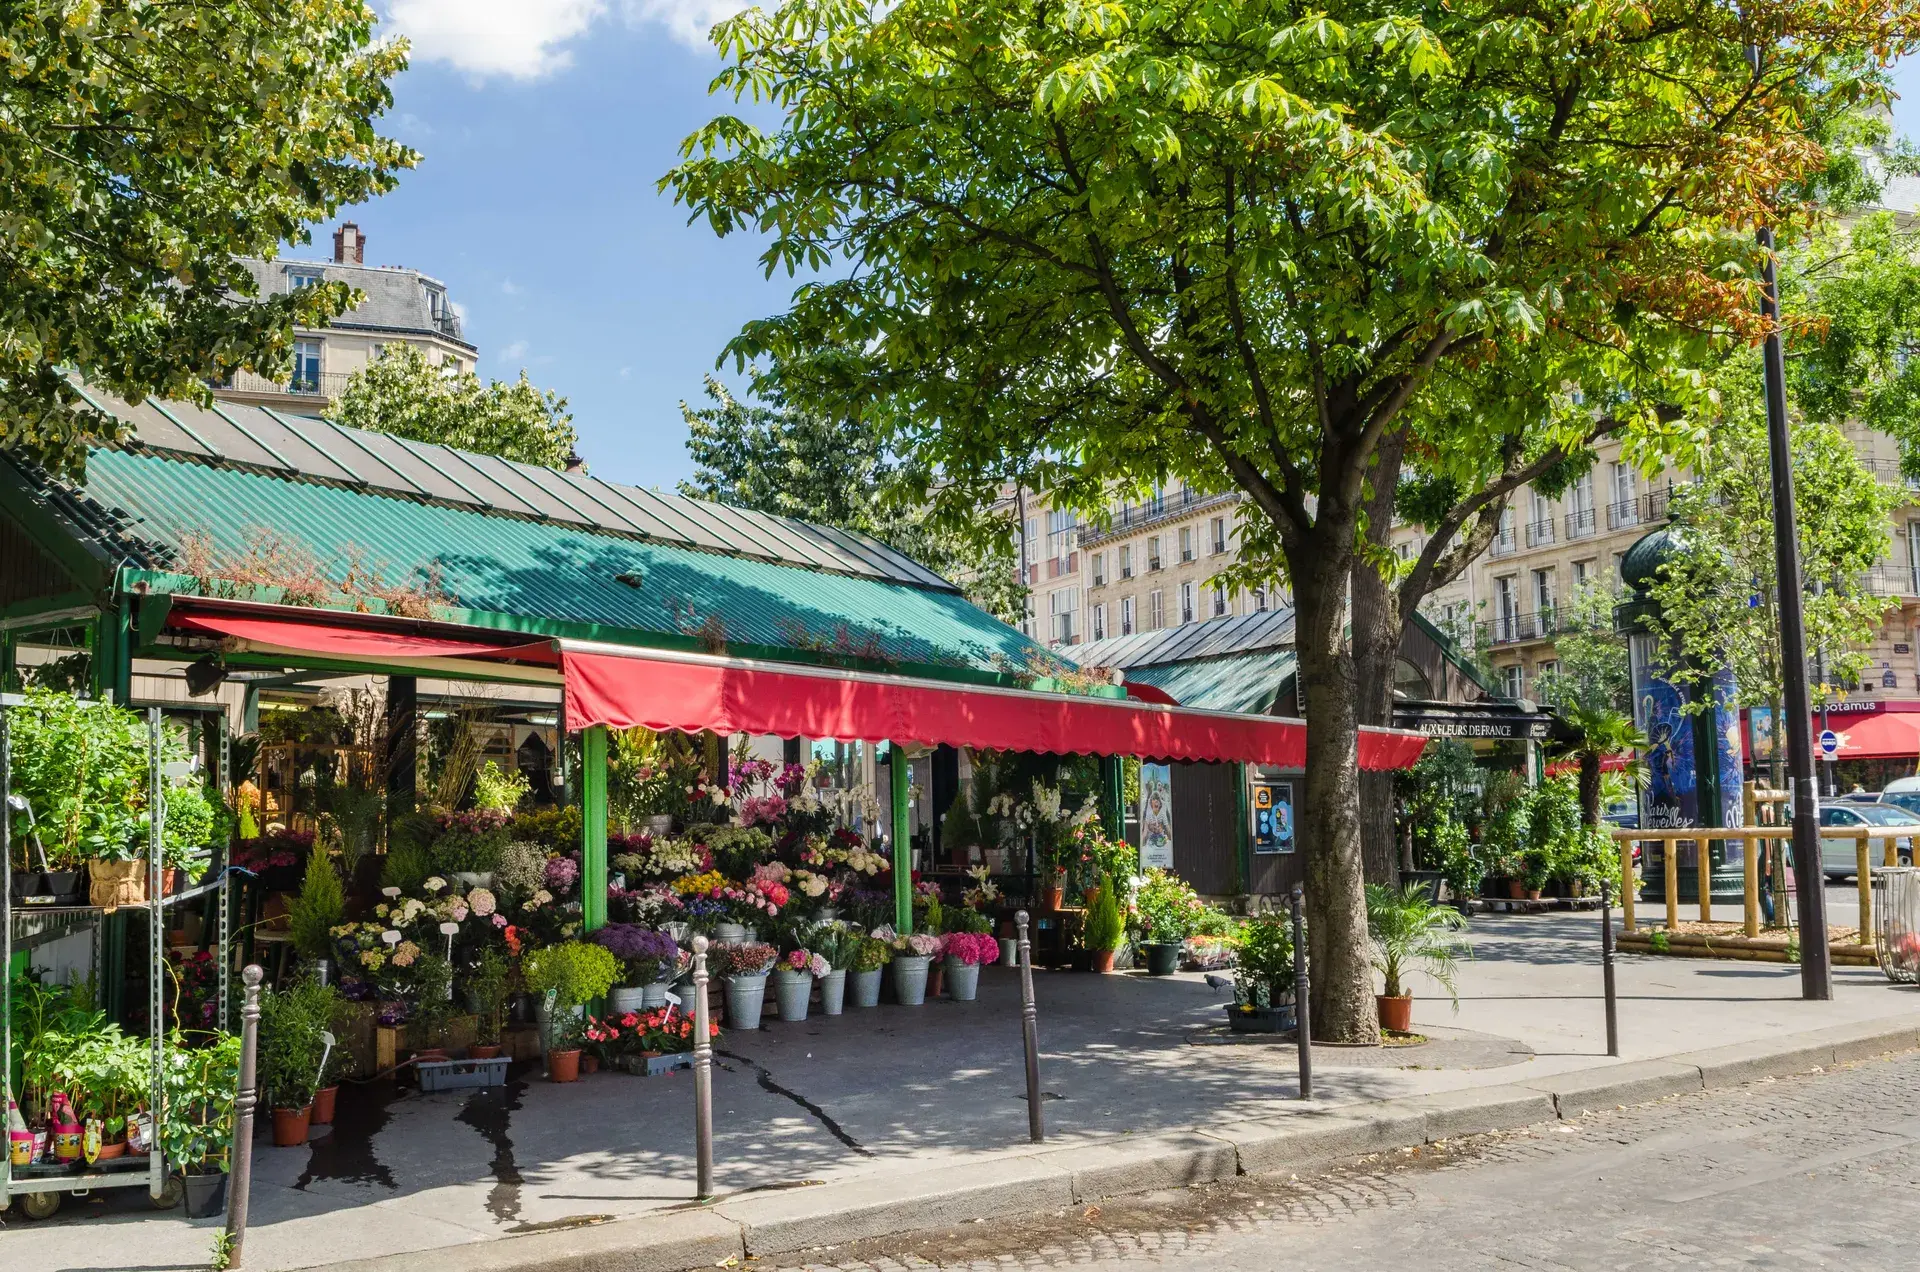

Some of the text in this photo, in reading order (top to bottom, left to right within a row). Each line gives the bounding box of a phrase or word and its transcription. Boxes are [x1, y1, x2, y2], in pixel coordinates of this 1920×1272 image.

[1420, 724, 1511, 736] AUX FLEURS DE FRANCE
